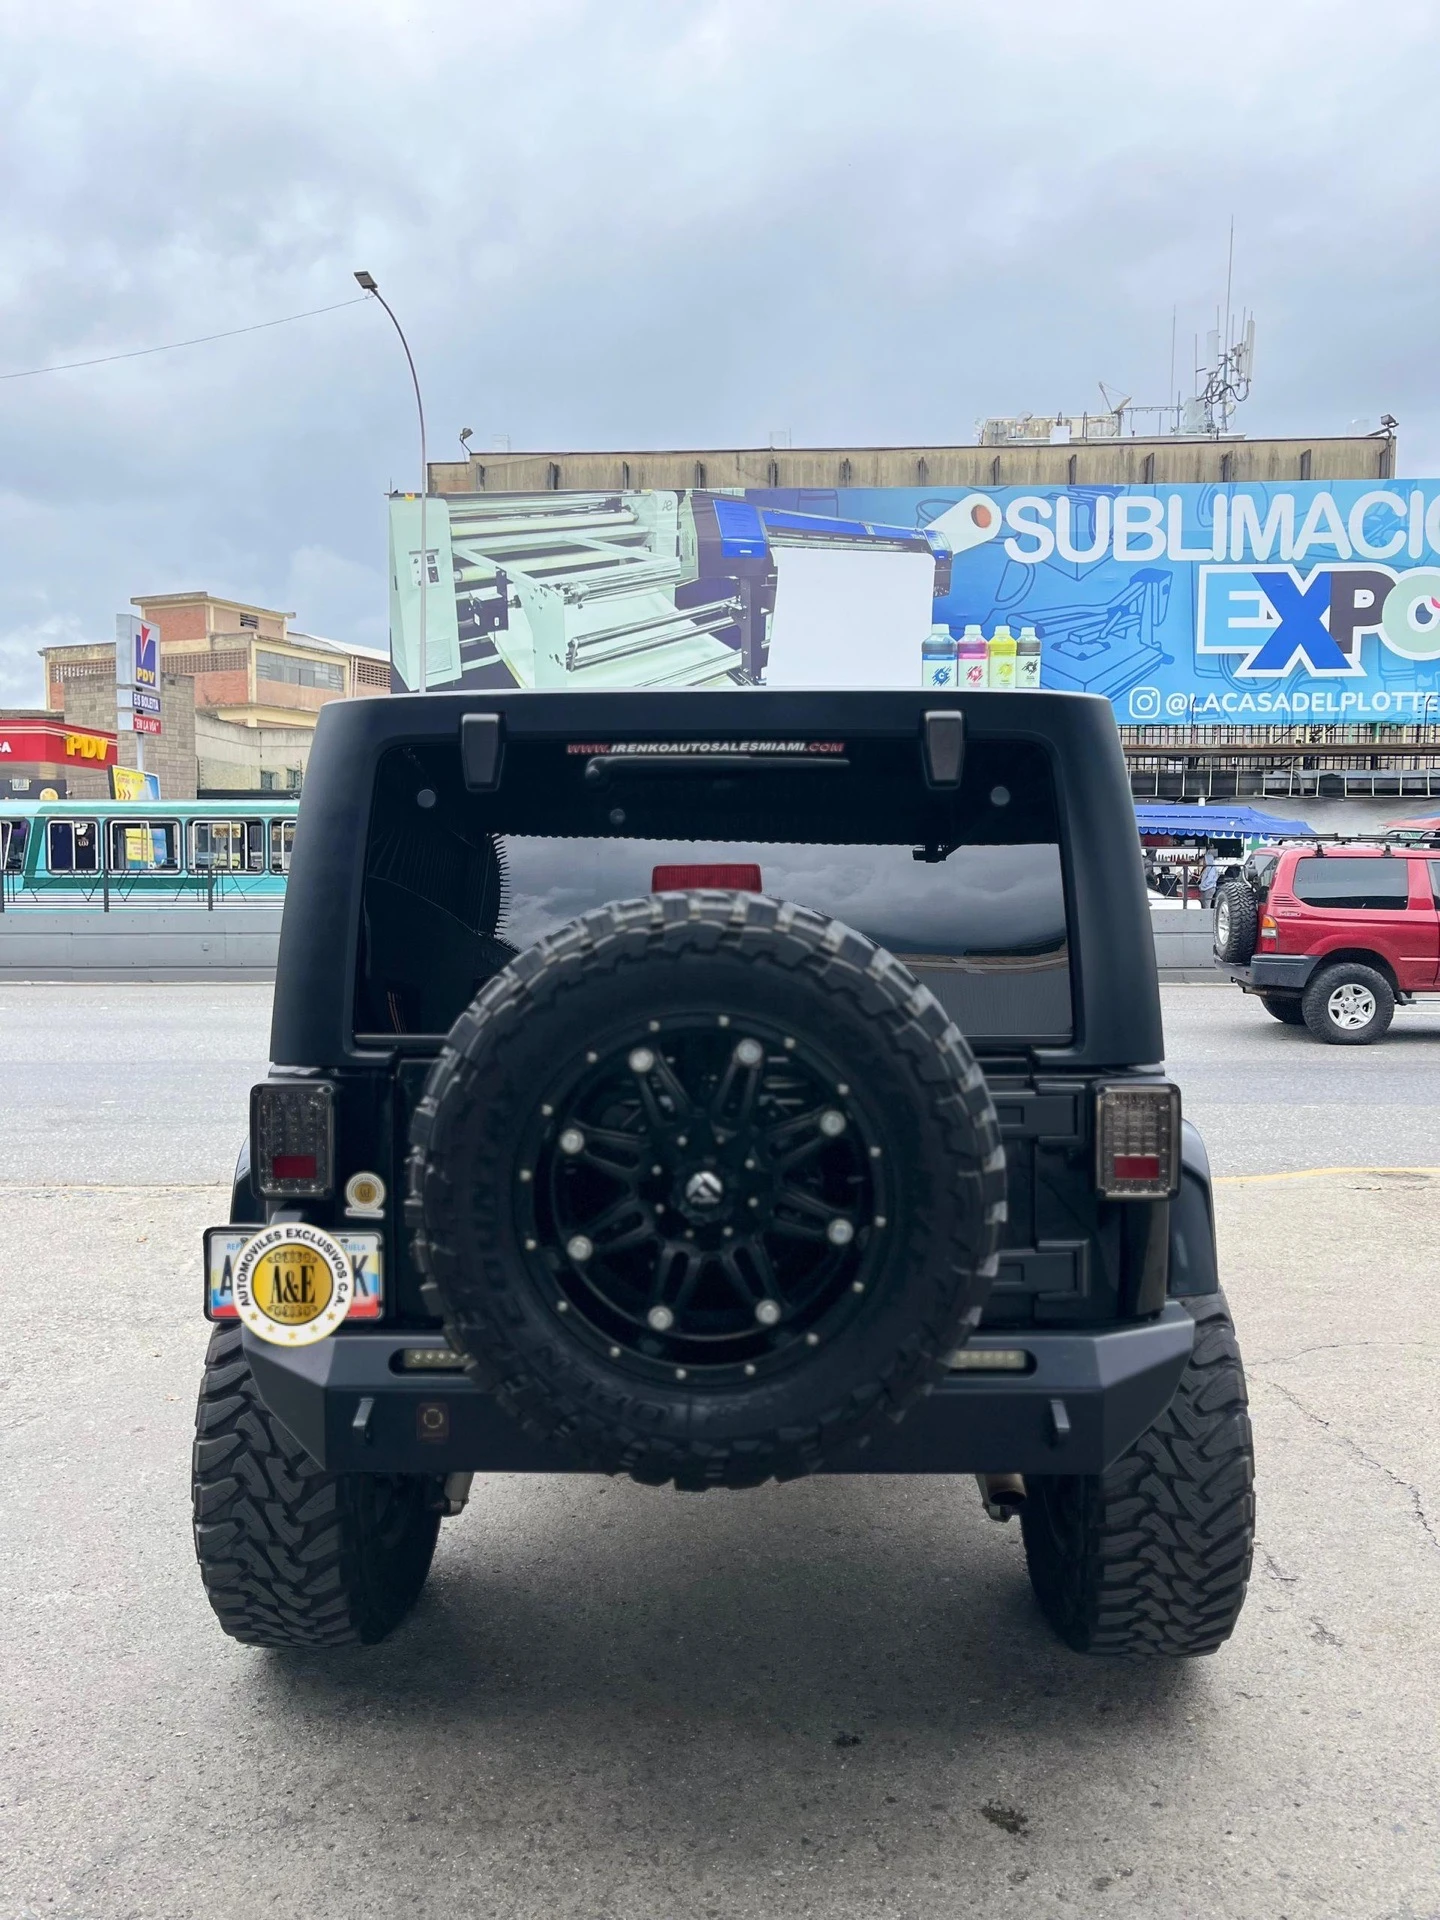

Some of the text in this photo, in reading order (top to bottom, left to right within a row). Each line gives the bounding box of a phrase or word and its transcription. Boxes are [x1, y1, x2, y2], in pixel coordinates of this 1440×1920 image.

[1004, 491, 1440, 563] SUBLIMACI
[1199, 565, 1440, 675] EXPO
[137, 667, 155, 684] PDV
[143, 719, 149, 730] LA
[66, 733, 108, 760] PDV
